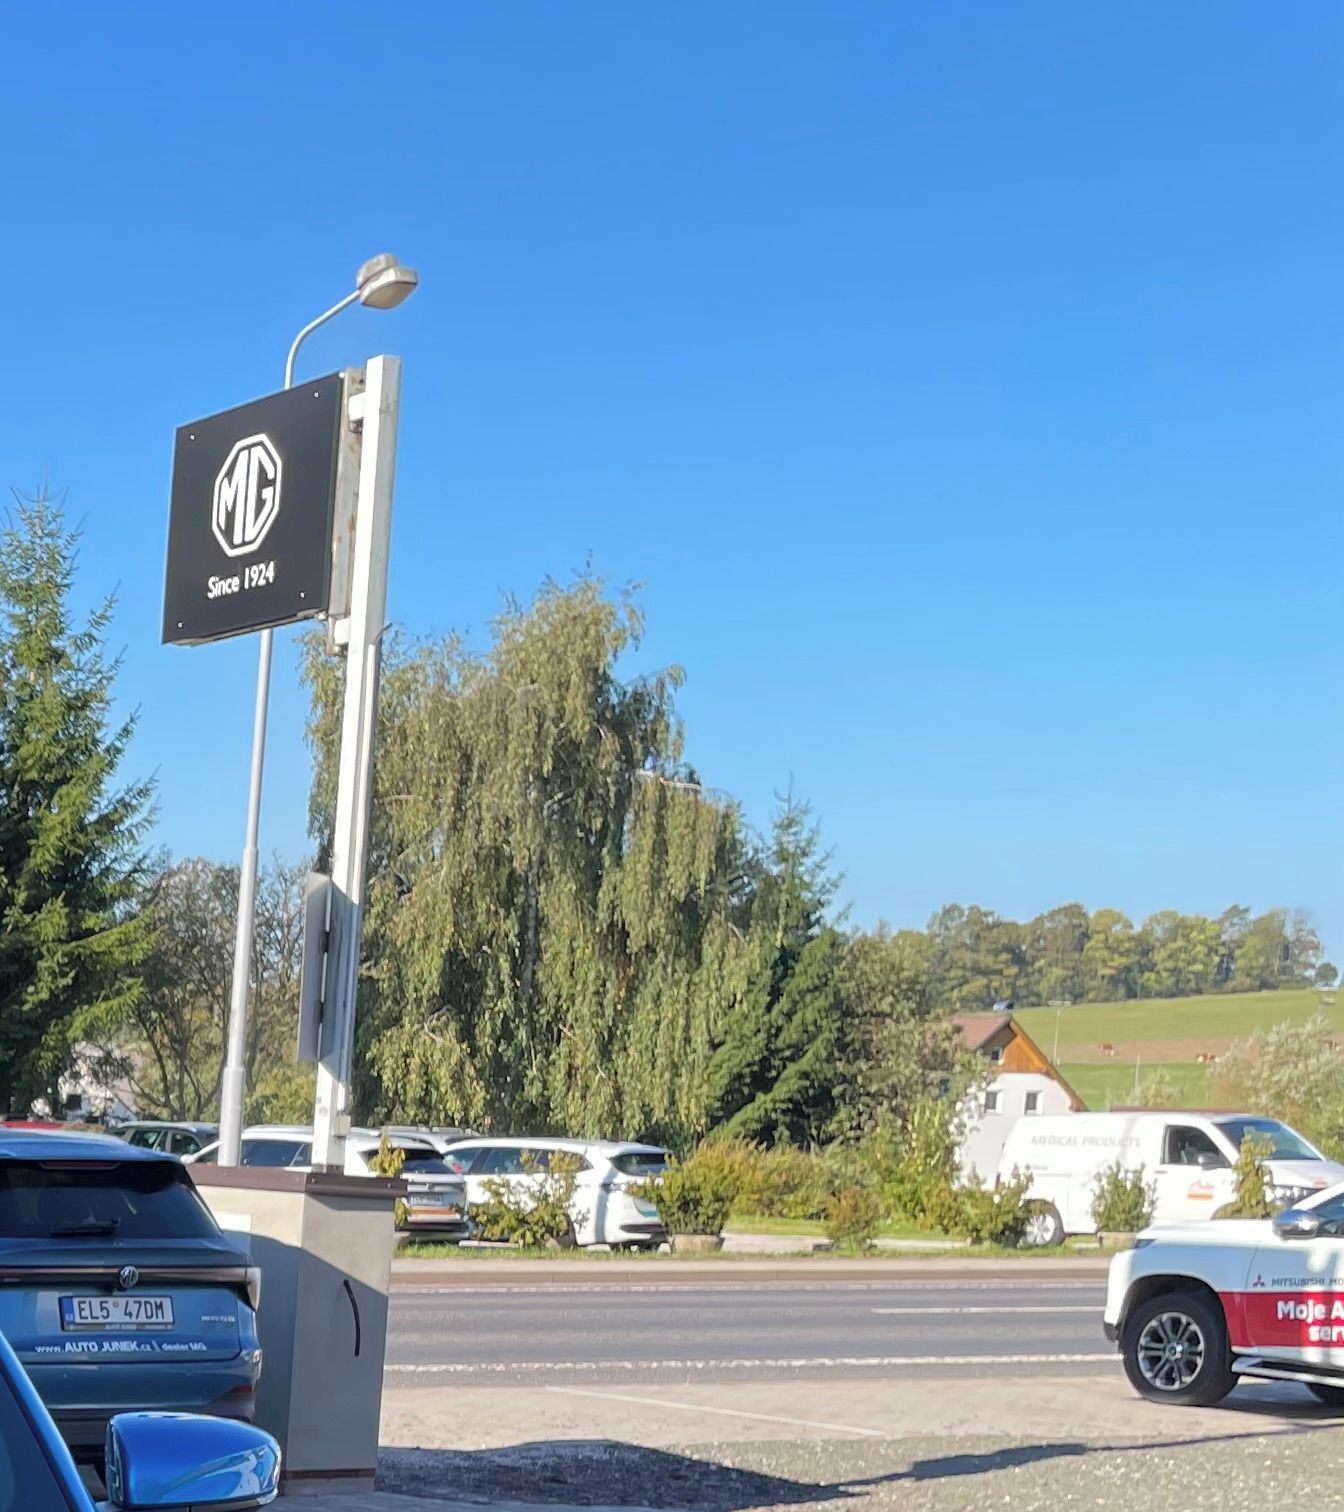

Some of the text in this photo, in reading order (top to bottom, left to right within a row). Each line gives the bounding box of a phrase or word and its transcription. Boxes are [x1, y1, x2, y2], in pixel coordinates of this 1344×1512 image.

[215, 442, 278, 548] MG
[207, 560, 275, 600] Since 1924
[1271, 1277, 1325, 1287] MITSUBISHI
[77, 1300, 165, 1321] EL5 47DM
[1276, 1299, 1327, 1325] Moje
